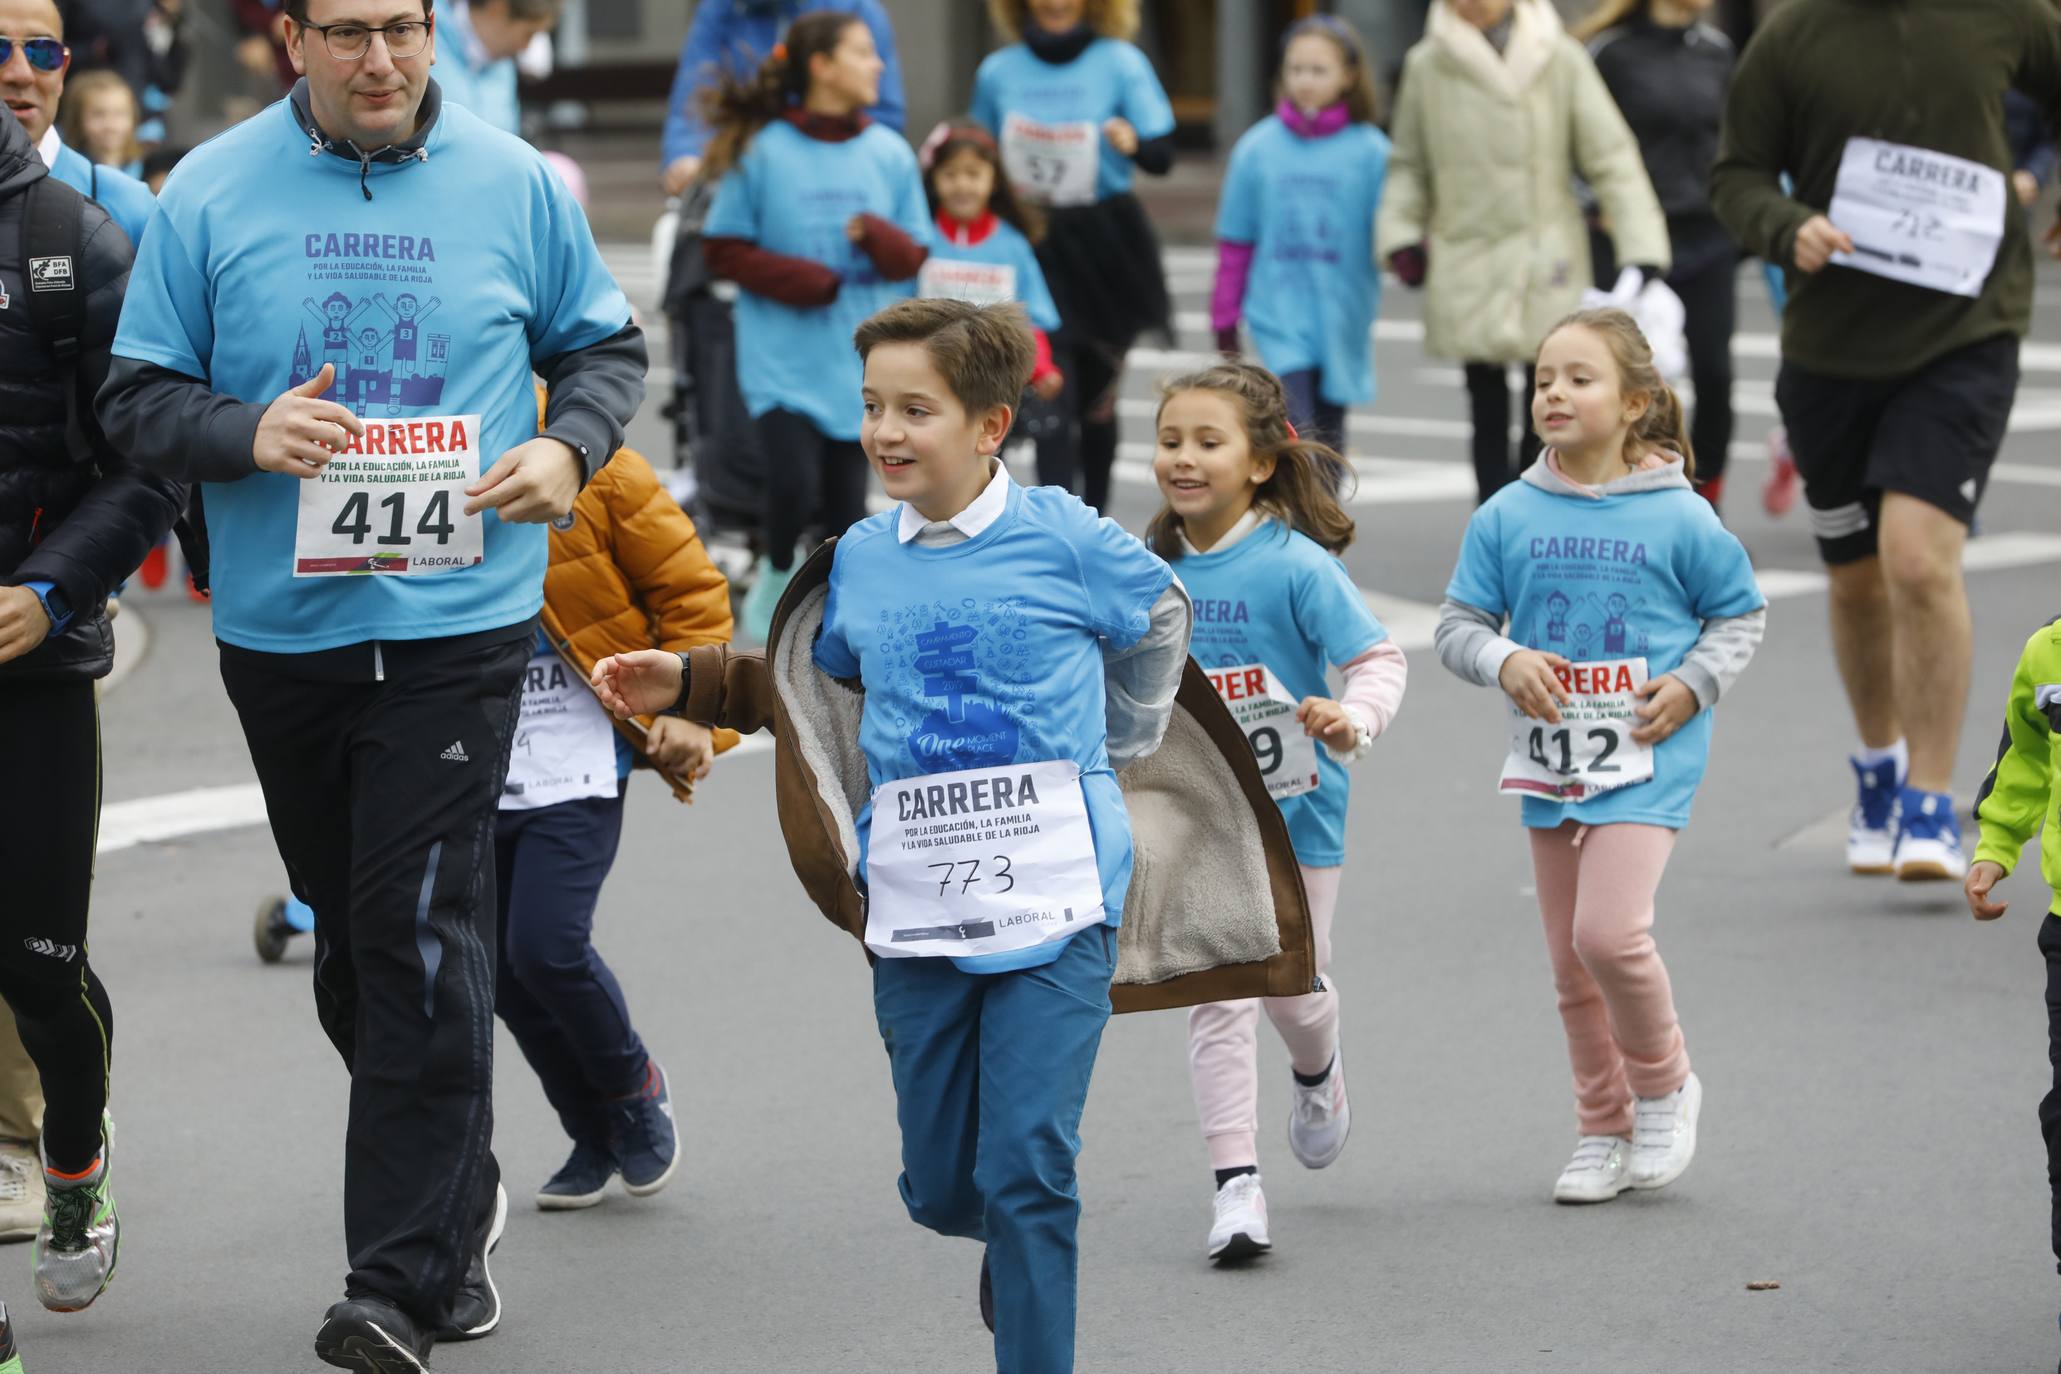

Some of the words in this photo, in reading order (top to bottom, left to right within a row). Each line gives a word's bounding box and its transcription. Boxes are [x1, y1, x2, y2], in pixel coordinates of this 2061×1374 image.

[305, 232, 436, 262] CARRERA
[307, 272, 312, 280] Y
[314, 272, 324, 280] LA
[325, 272, 343, 280] VIDA
[344, 272, 387, 281] SALUDABLE
[389, 274, 398, 282] DE
[400, 275, 409, 283] LA
[411, 275, 433, 284] RIOJA
[313, 263, 328, 271] POR
[329, 263, 340, 271] LA
[386, 264, 397, 272] LA
[397, 265, 427, 275] FAMILIA
[320, 420, 468, 455] ARRERA
[321, 474, 327, 483] Y
[329, 474, 341, 483] LA
[343, 474, 365, 483] VIDA
[367, 473, 417, 483] SALUDABLE
[419, 472, 429, 482] DE
[431, 472, 442, 481] LA
[443, 470, 466, 480] RIOJA
[328, 461, 346, 471] POR
[350, 461, 361, 471] LA
[363, 460, 415, 472] EDUCACIÓN,
[416, 461, 427, 470] LA
[428, 459, 460, 469] FAMILIA
[332, 490, 454, 545] 414
[413, 557, 465, 566] LABORAL
[1530, 536, 1648, 566] CARRERA
[1253, 712, 1264, 722] LA
[440, 752, 469, 762] adidas
[917, 733, 965, 757] One
[967, 731, 1007, 744] MOMENT
[1248, 726, 1283, 776] 9
[1529, 726, 1621, 775] 412
[897, 774, 1040, 822] CARRERA
[901, 841, 906, 851] Y
[907, 841, 916, 850] LA
[917, 838, 933, 849] VIDA
[934, 832, 983, 847] SALUDABLE
[985, 831, 997, 840] DE
[1000, 829, 1011, 839] LA
[1014, 824, 1040, 837] RIOJA
[905, 827, 919, 838] POR
[919, 827, 928, 836] LA
[929, 820, 978, 835] EDUCACIÓN,
[980, 818, 992, 828] LA
[995, 813, 1032, 827] FAMILIA
[927, 855, 1014, 897] 773
[999, 911, 1056, 928] LABORAL
